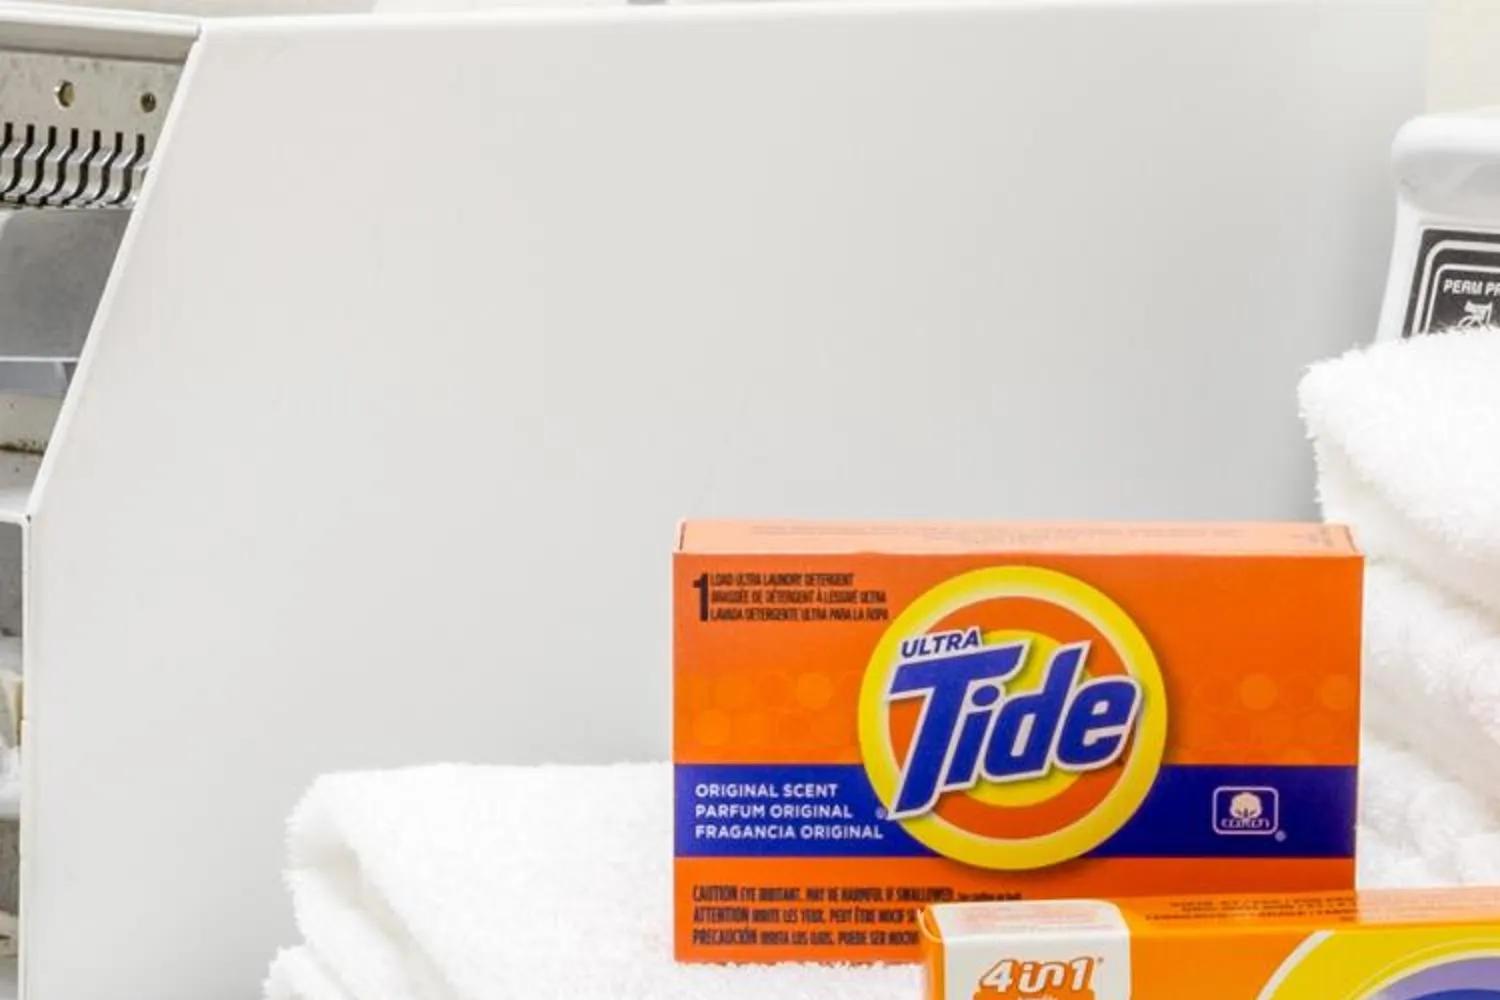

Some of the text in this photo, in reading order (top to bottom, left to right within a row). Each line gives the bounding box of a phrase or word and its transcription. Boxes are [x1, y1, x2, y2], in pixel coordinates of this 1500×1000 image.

[1443, 279, 1483, 295] PERM
[711, 573, 854, 586] LOAD ULTRA LAUNDRY DETERGENT
[692, 573, 708, 621] 1
[801, 608, 827, 621] ULTRA
[829, 608, 851, 621] PARA
[901, 629, 979, 658] ULTRA
[886, 641, 1139, 817] Tide
[695, 784, 838, 798] ORIGINAL SCENT
[695, 804, 853, 818] PARFUM ORIGINAL
[695, 825, 883, 839] FRAGANCIA ORIGINAL
[693, 885, 738, 901] CAUTION
[693, 906, 749, 922] ATTENTION
[693, 927, 758, 945] PRECAUCIÓN
